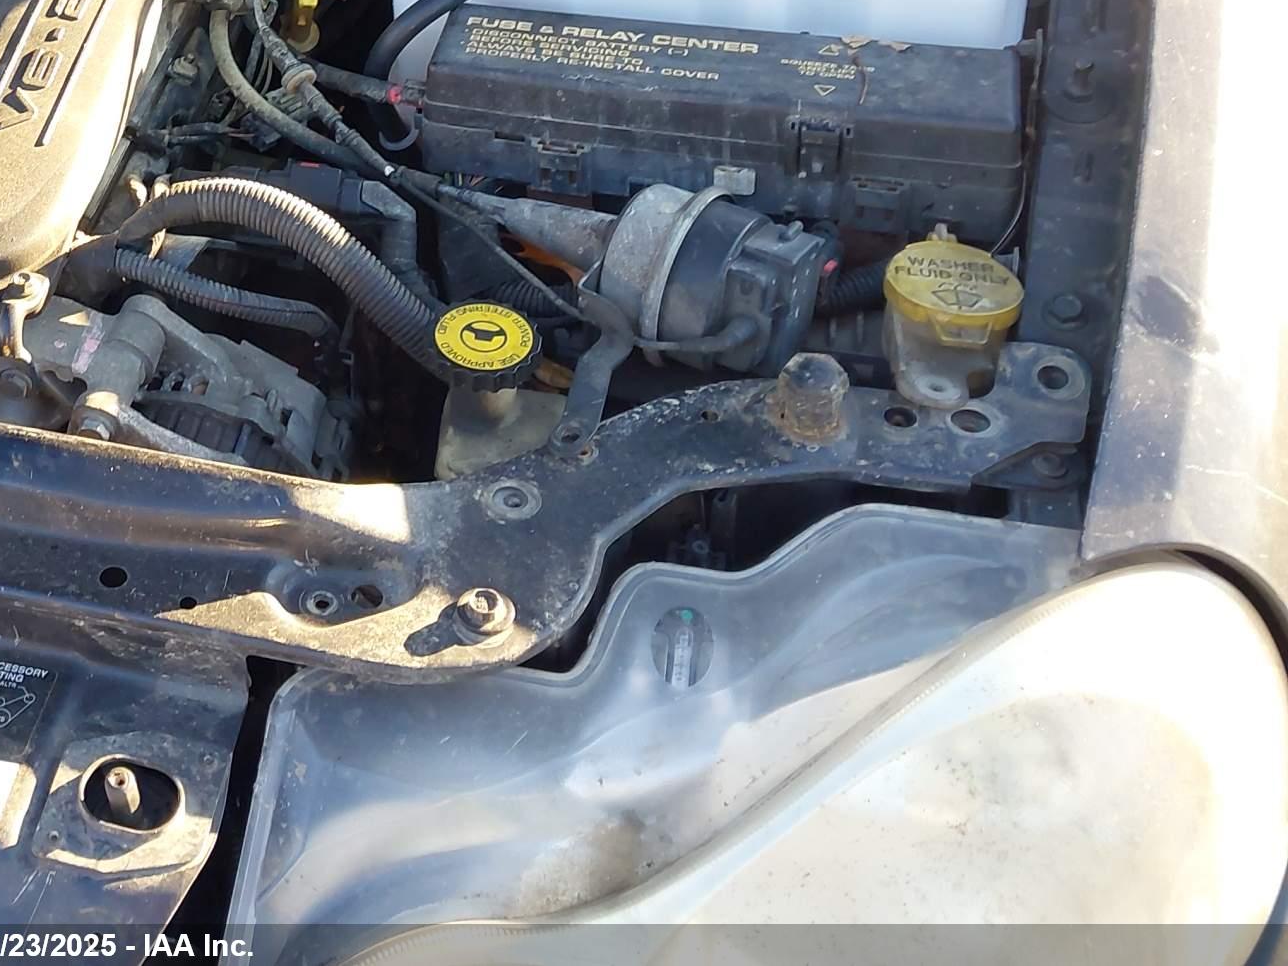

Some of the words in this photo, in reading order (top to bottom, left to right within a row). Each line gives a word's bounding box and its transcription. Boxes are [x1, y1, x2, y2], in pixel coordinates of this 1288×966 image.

[466, 17, 533, 32] FUSE
[562, 26, 646, 42] RELAY
[652, 35, 760, 54] CENTER
[469, 35, 534, 47] BEFORE
[539, 42, 631, 57] SERVICING
[472, 28, 578, 45] DISCONNECT
[585, 40, 668, 55] BATTERY
[464, 47, 551, 63] PROPERLY
[557, 57, 654, 74] RE-INSTALL
[661, 67, 720, 80] COVER
[466, 41, 536, 54] ALWAYS
[542, 49, 563, 57] BE
[569, 52, 616, 62] SURE
[622, 56, 644, 65] TO
[894, 265, 953, 279] FLUID
[959, 272, 1010, 285] ONLY
[907, 256, 995, 273] WASHER
[455, 304, 512, 319] STEERING
[437, 315, 457, 335] FLUID
[512, 317, 531, 347] POWER
[440, 341, 494, 368] APPROVED
